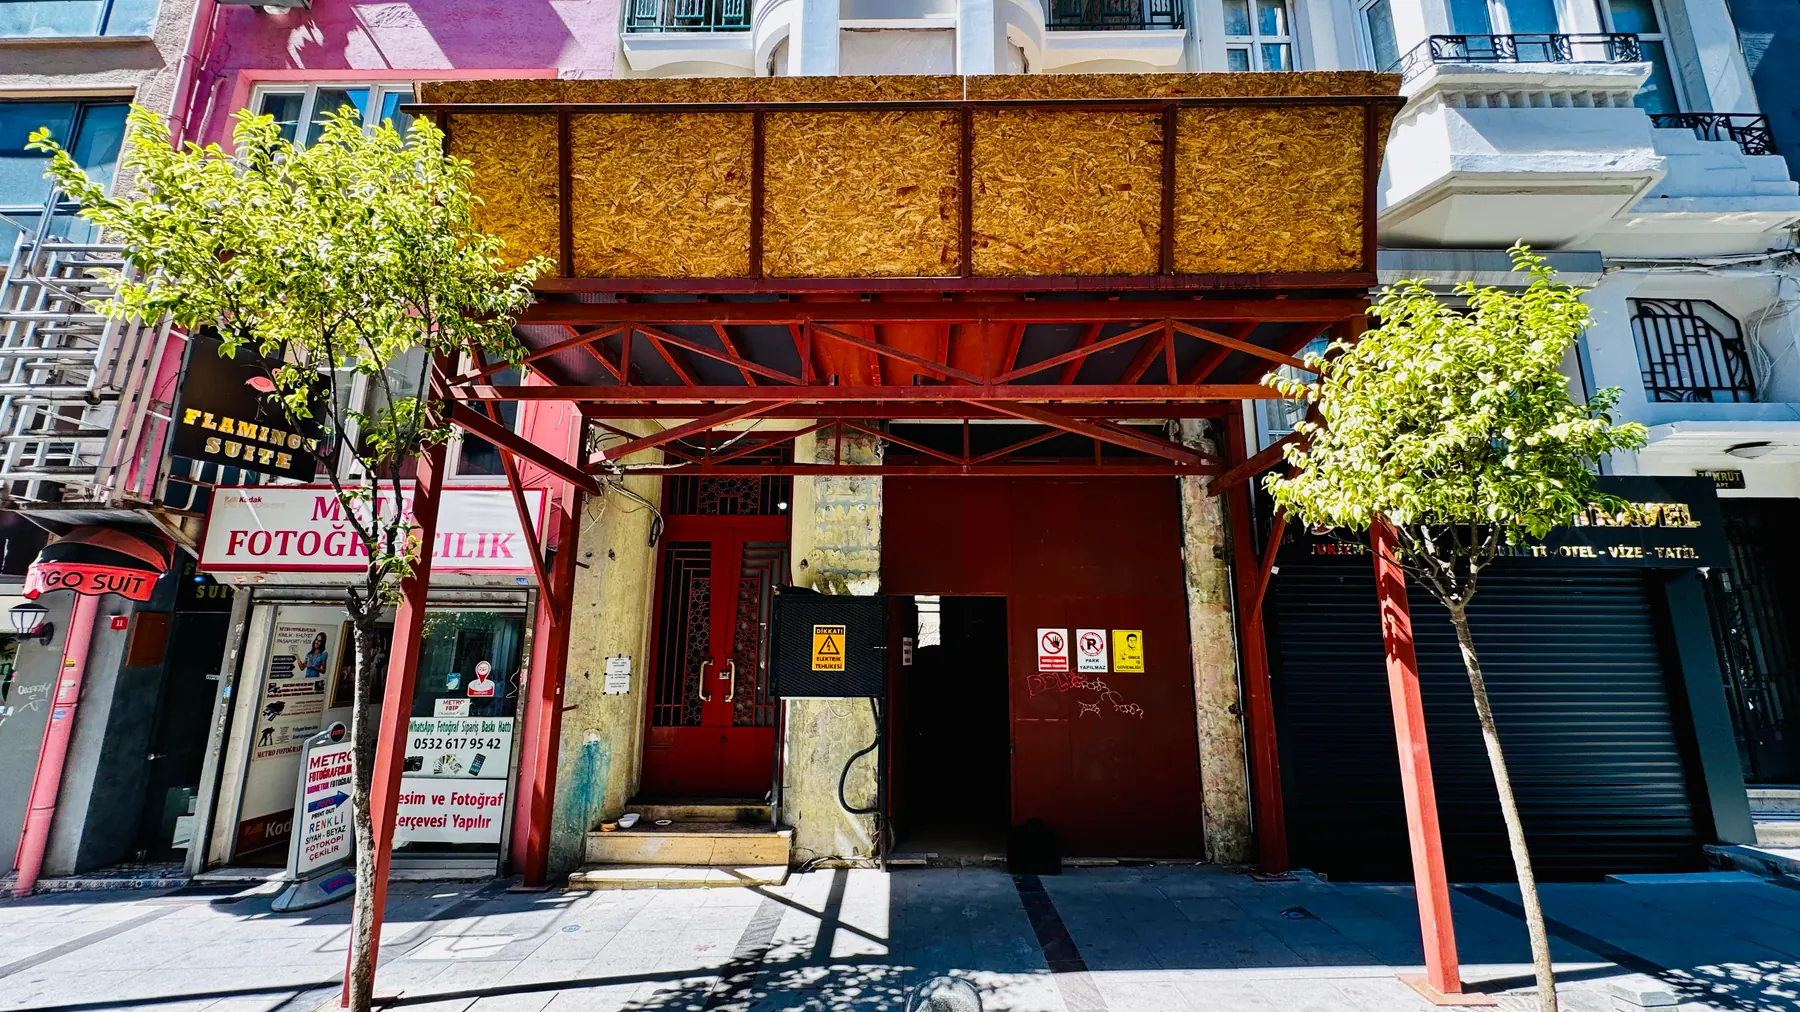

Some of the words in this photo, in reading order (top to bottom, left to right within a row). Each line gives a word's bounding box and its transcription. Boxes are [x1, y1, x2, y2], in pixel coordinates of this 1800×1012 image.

[183, 408, 312, 453] FLAMING
[204, 437, 293, 470] SUITE
[1573, 502, 1701, 528] TRAVEL
[1559, 546, 1597, 558] OTEL
[1608, 544, 1643, 558] VİZE
[1655, 545, 1699, 558] TATİL
[196, 585, 237, 599] SUI
[437, 720, 460, 736] Fotoğraf
[461, 720, 479, 735] Sipariş
[414, 738, 442, 750] 0532
[445, 738, 468, 750] 617
[469, 738, 484, 750] 95
[486, 738, 501, 750] 42
[398, 791, 426, 805] esim
[431, 794, 446, 806] ve
[450, 792, 504, 810] Fotoğraf
[325, 807, 335, 816] OUT
[265, 817, 293, 838] Kod
[309, 812, 344, 834] RENKLİ
[395, 813, 447, 831] erçevesi
[452, 813, 491, 831] Yapılır
[305, 832, 322, 845] SİYAH
[326, 825, 346, 838] BEYAZ
[305, 834, 344, 853] FOTOKOPİ
[309, 845, 339, 862] ÇEKİLİR
